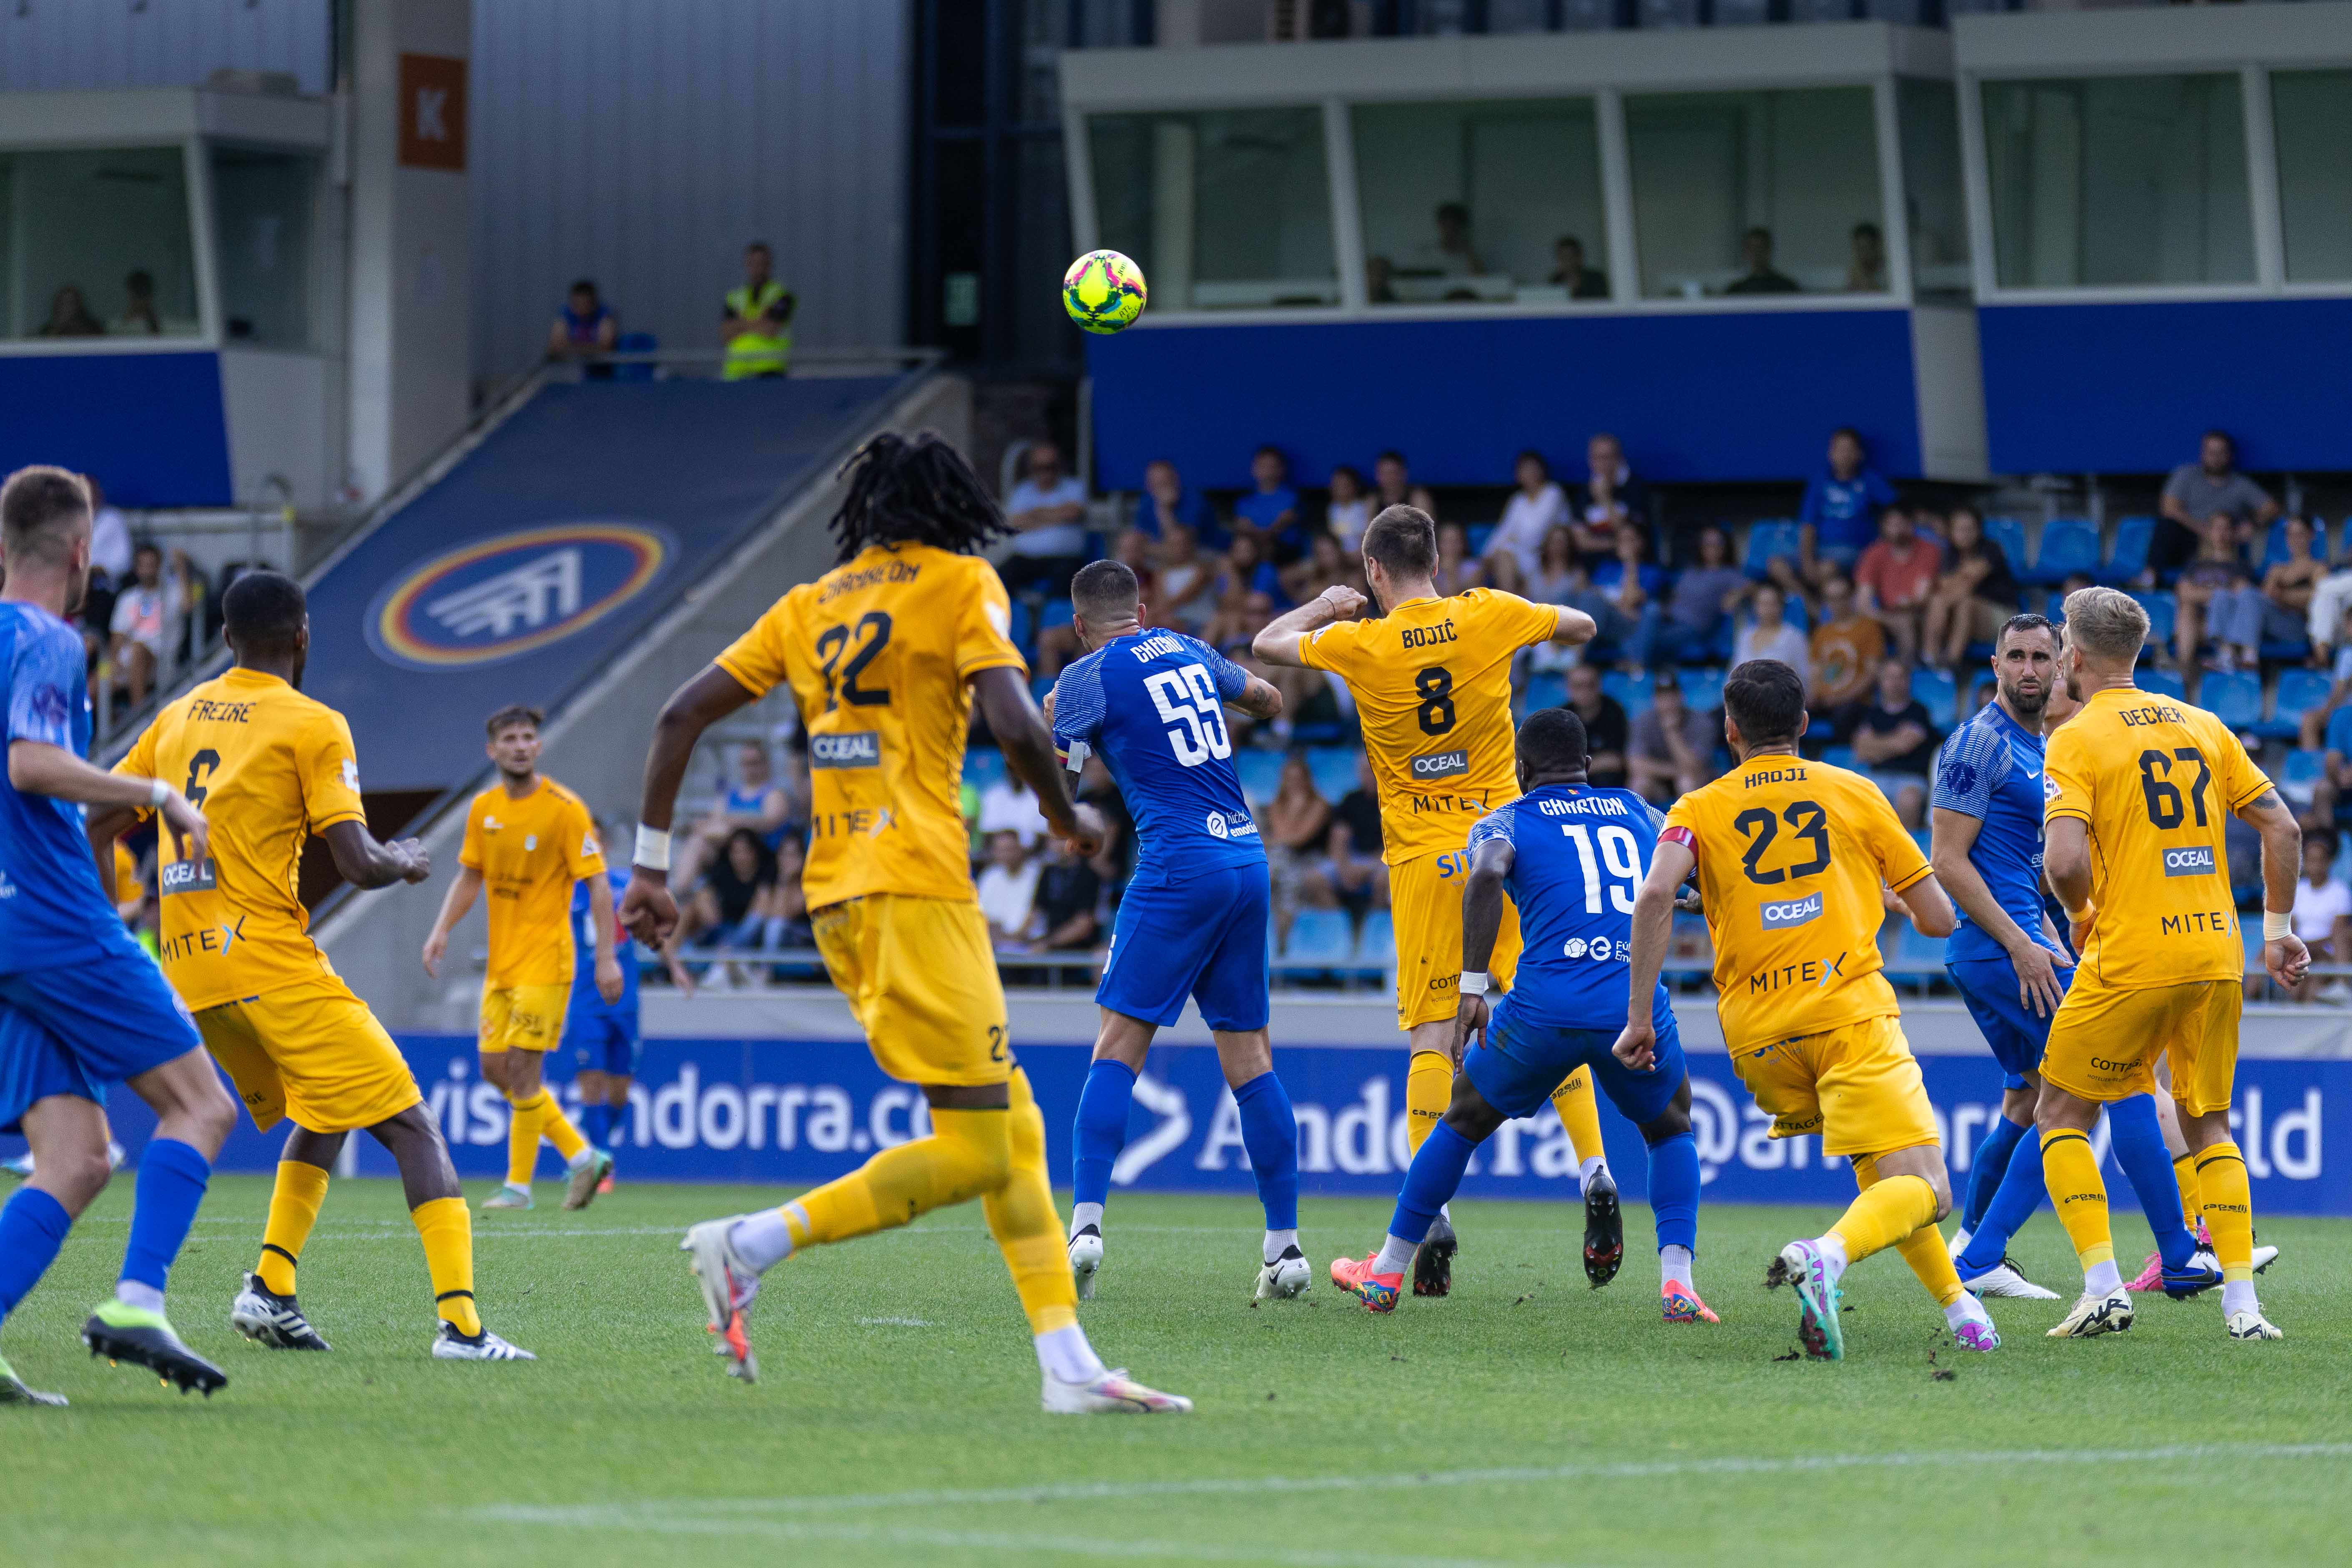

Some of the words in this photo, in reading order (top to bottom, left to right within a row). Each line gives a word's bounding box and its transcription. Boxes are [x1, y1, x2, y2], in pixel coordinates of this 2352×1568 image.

[418, 86, 447, 140] K
[1402, 618, 1458, 649] BOJIĆ
[816, 612, 891, 713] 22
[188, 699, 256, 723] FREIRE
[1143, 663, 1231, 767] 55
[1415, 666, 1456, 736] 8
[2118, 706, 2186, 727] DECKER
[1415, 754, 1465, 773] OCEAL
[1745, 768, 1807, 789] HADJI
[185, 749, 220, 811] 6
[2139, 748, 2211, 830] 67
[1413, 789, 1494, 815] MITEX
[1734, 800, 1831, 885] 23
[1561, 824, 1643, 915] 19
[2166, 850, 2213, 868] OCEAL
[1765, 898, 1820, 921] OCEAL
[2161, 904, 2239, 938] MITEX
[162, 915, 247, 964] MITEX
[1750, 952, 1847, 995] MITEX
[1551, 1078, 1581, 1101] apelli
[2064, 1193, 2106, 1204] capelli
[2203, 1203, 2248, 1212] capelli
